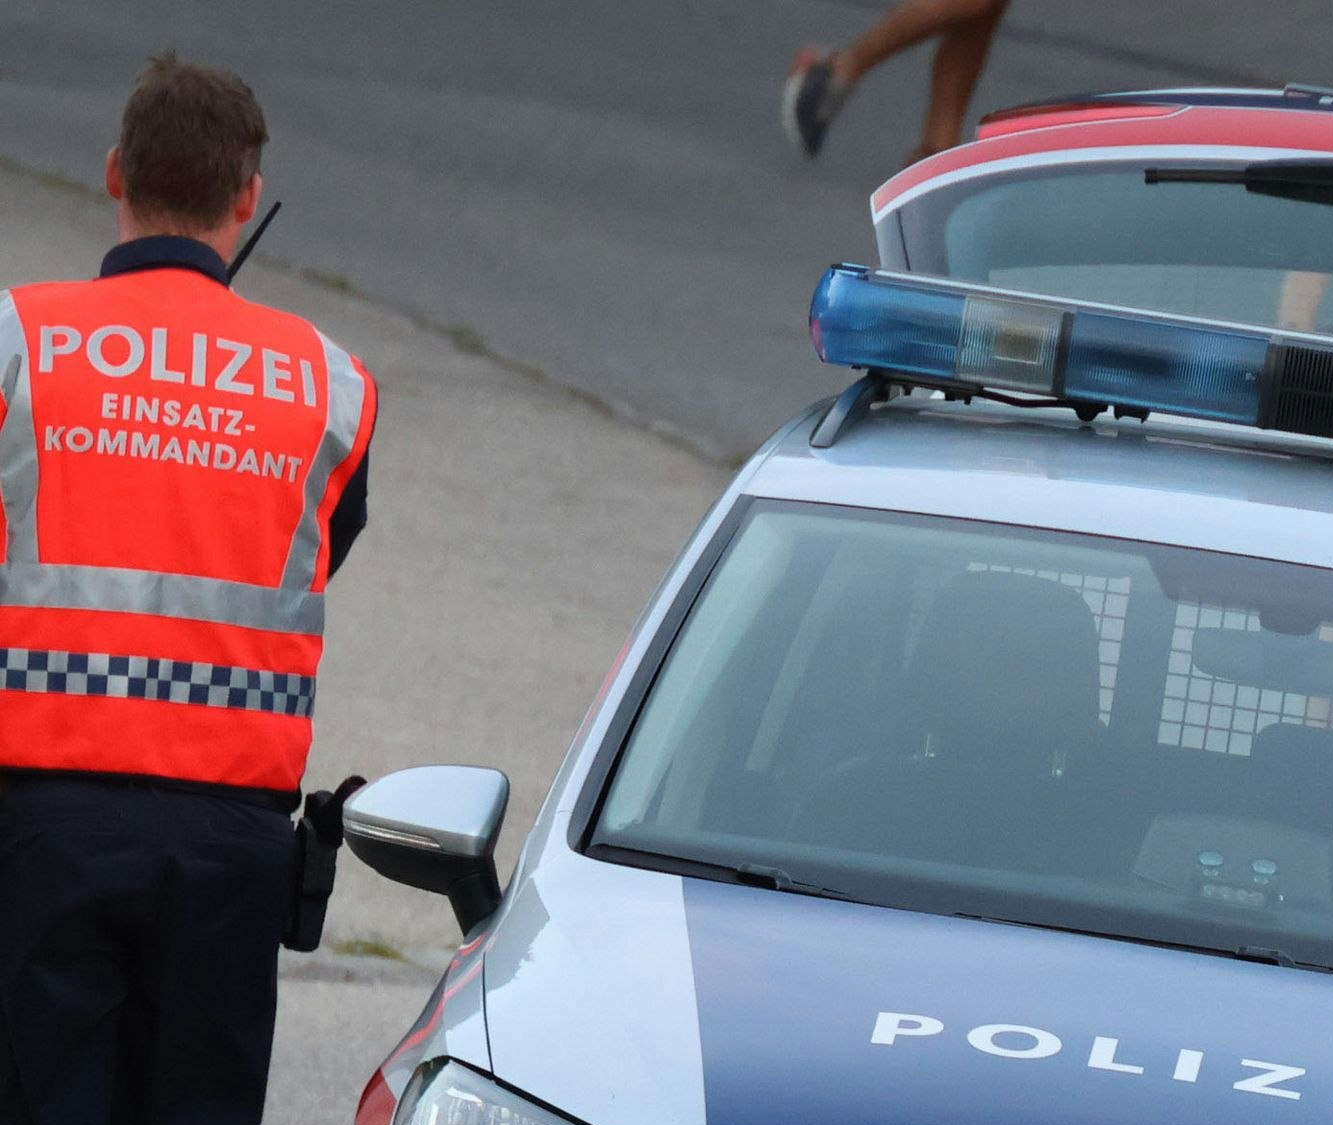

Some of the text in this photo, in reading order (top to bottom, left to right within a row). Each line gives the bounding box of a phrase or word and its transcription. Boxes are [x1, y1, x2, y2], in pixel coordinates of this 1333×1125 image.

[38, 324, 317, 407] POLIZEI
[101, 393, 256, 436] EINSATZ-
[44, 425, 303, 482] KOMMANDANT
